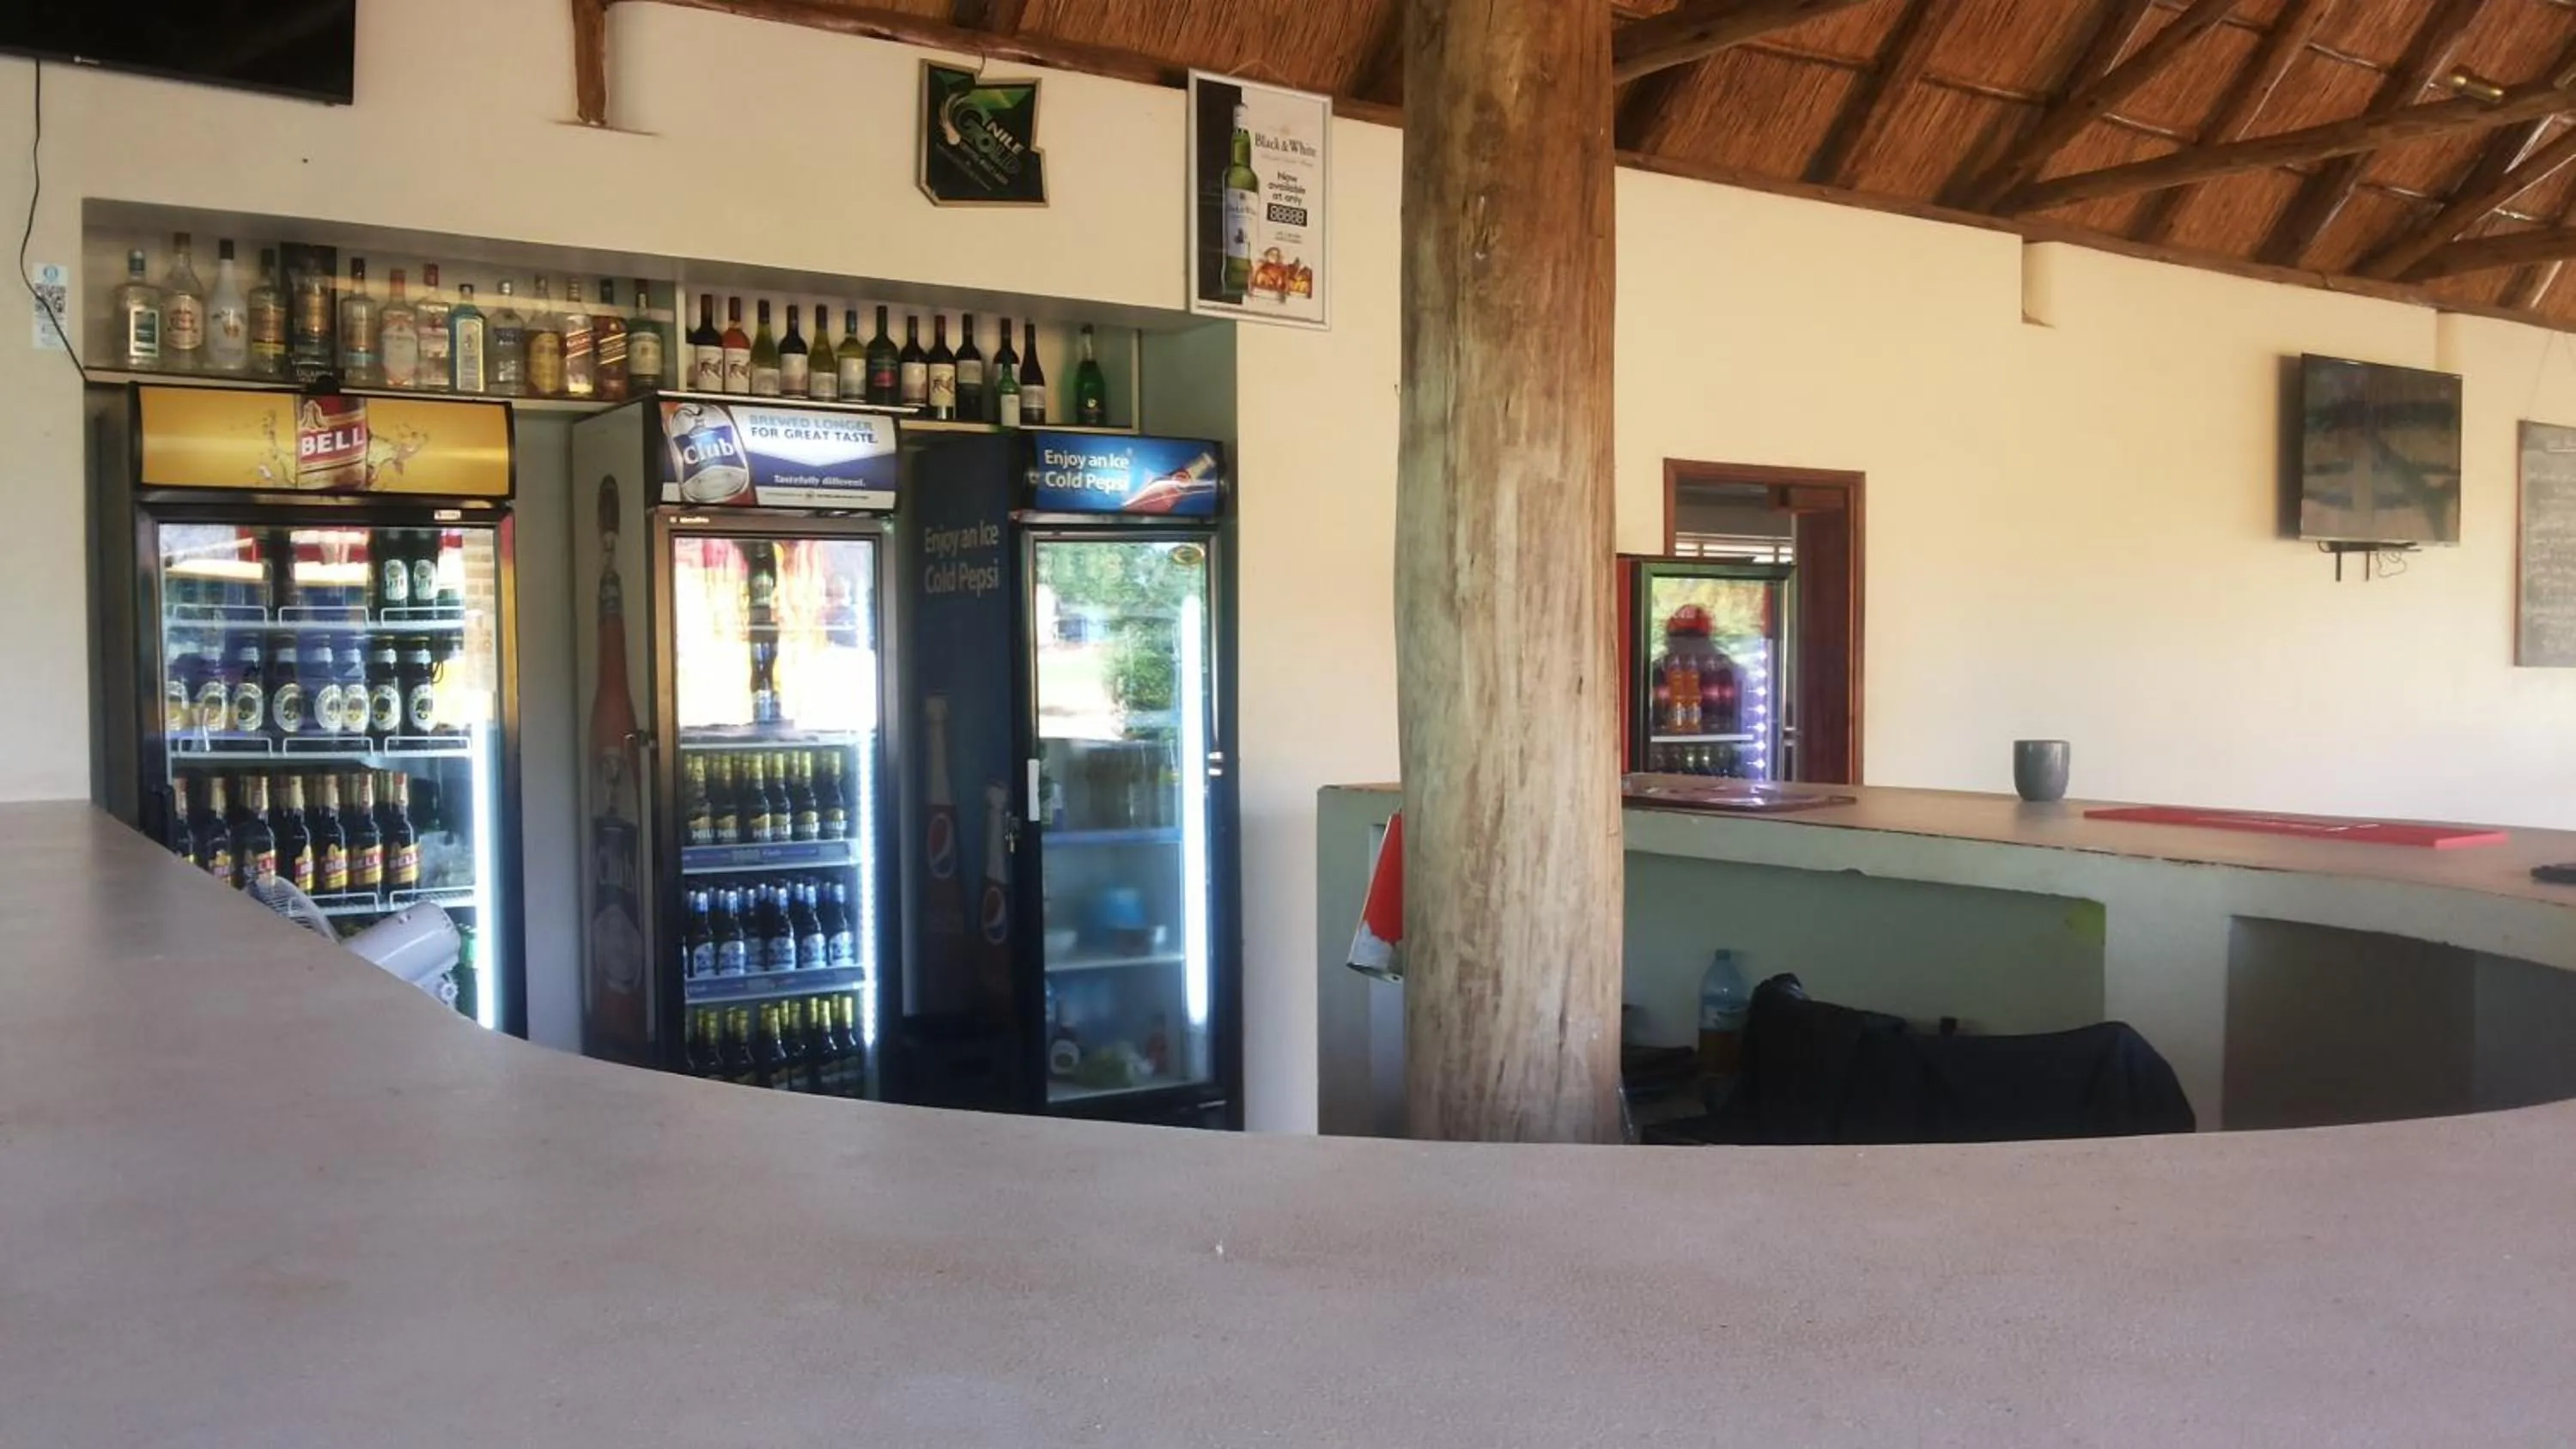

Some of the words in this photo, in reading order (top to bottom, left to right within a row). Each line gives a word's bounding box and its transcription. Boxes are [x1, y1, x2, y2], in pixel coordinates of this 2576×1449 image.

[986, 121, 1024, 155] NILE
[1255, 132, 1279, 151] Black
[750, 415, 811, 428] BREWED
[815, 419, 873, 432] LONGER
[750, 427, 779, 438] FOR
[784, 428, 829, 441] GREAT
[835, 432, 879, 444] TASTE.
[301, 427, 364, 457] BELL
[684, 437, 734, 464] Club
[1044, 449, 1085, 470] Enjoy
[1088, 455, 1108, 468] an
[1108, 452, 1130, 470] Ice
[774, 475, 820, 487] Tastefully
[1045, 470, 1082, 488] Cold
[1085, 471, 1131, 495] Pepsi
[925, 524, 961, 559] Enjoy
[960, 527, 979, 549] an
[979, 518, 999, 546] Ice
[925, 561, 957, 594] Cold
[957, 557, 999, 598] Pepsi
